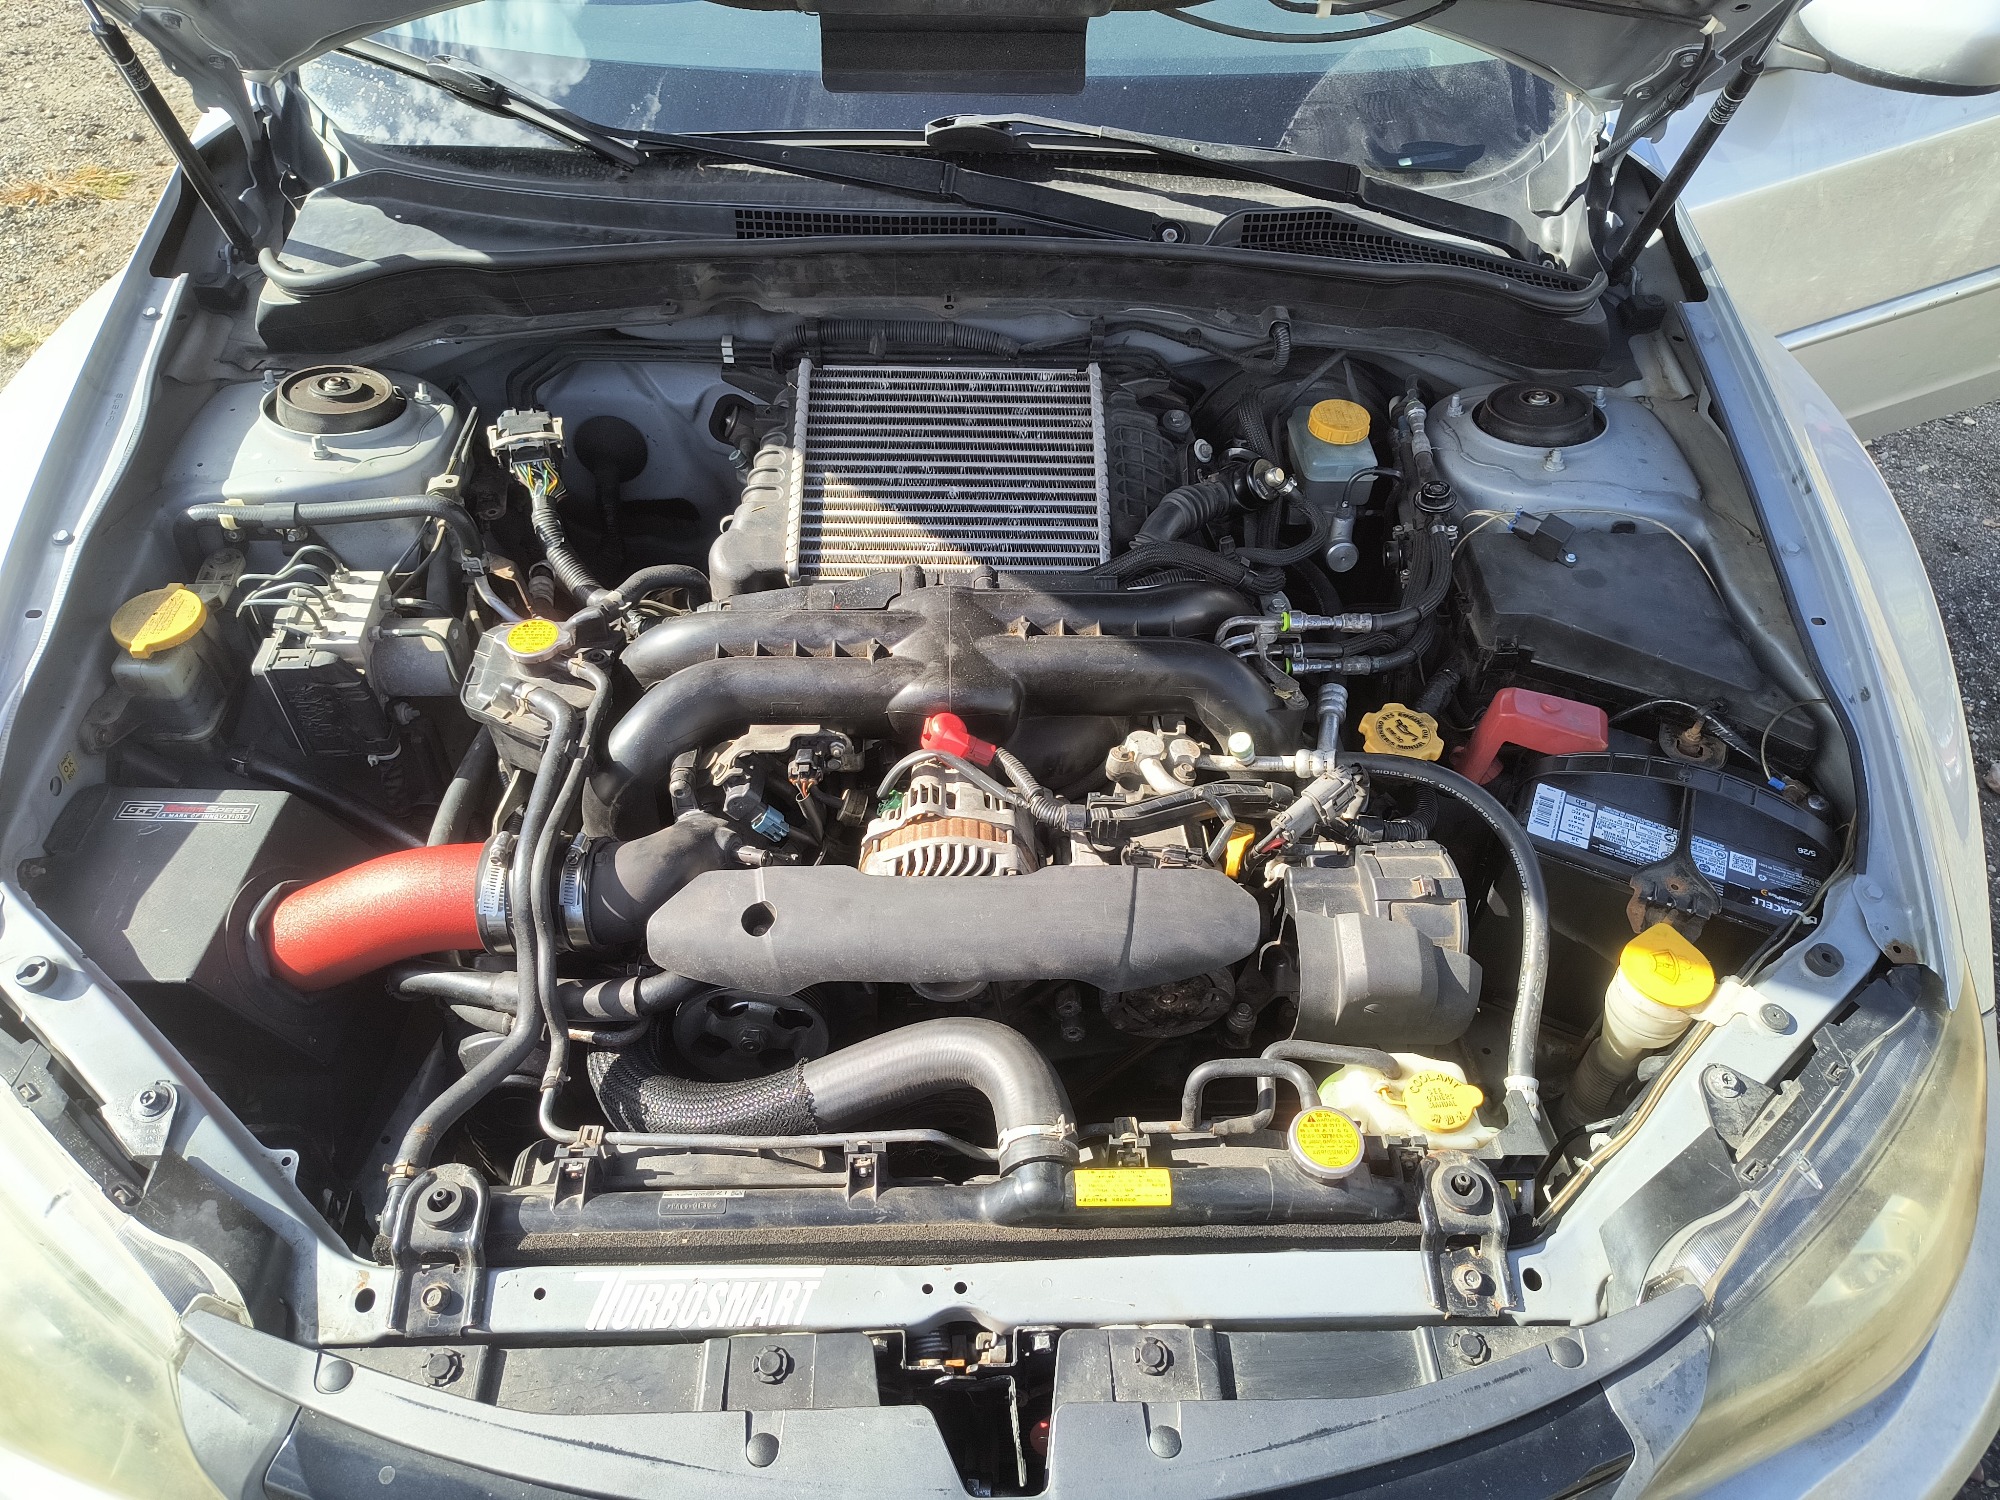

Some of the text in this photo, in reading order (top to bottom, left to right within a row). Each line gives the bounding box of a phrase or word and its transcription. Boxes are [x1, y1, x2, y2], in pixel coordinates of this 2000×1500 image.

[1574, 798, 1587, 807] Pb
[1797, 847, 1817, 857] 5/26
[1410, 1074, 1462, 1094] COOLANT
[573, 1267, 827, 1331] TURBOSMART
